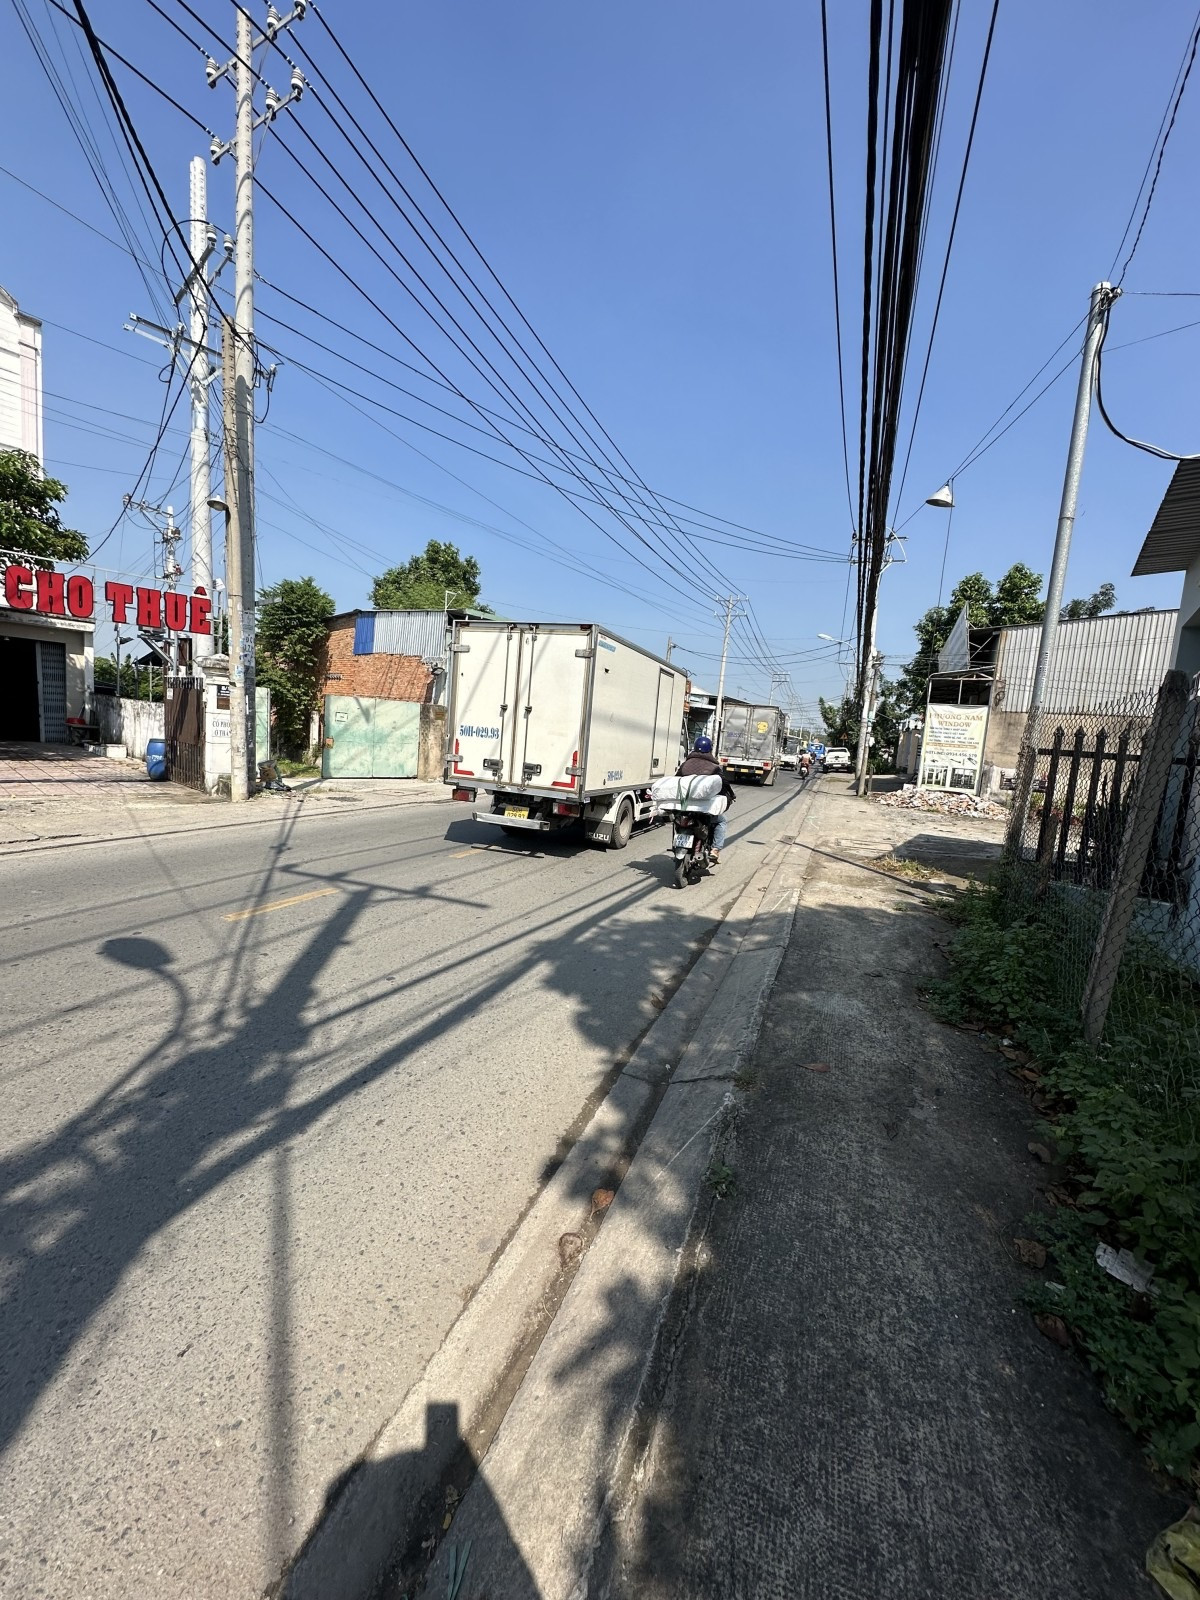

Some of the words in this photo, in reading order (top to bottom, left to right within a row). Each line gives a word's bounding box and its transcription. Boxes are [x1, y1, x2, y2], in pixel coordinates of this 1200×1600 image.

[5, 564, 94, 618] CHO
[105, 581, 212, 635] THUÊ
[938, 720, 972, 728] WINDOW
[459, 724, 500, 740] 50H-029.93
[586, 831, 610, 841] ISUZU
